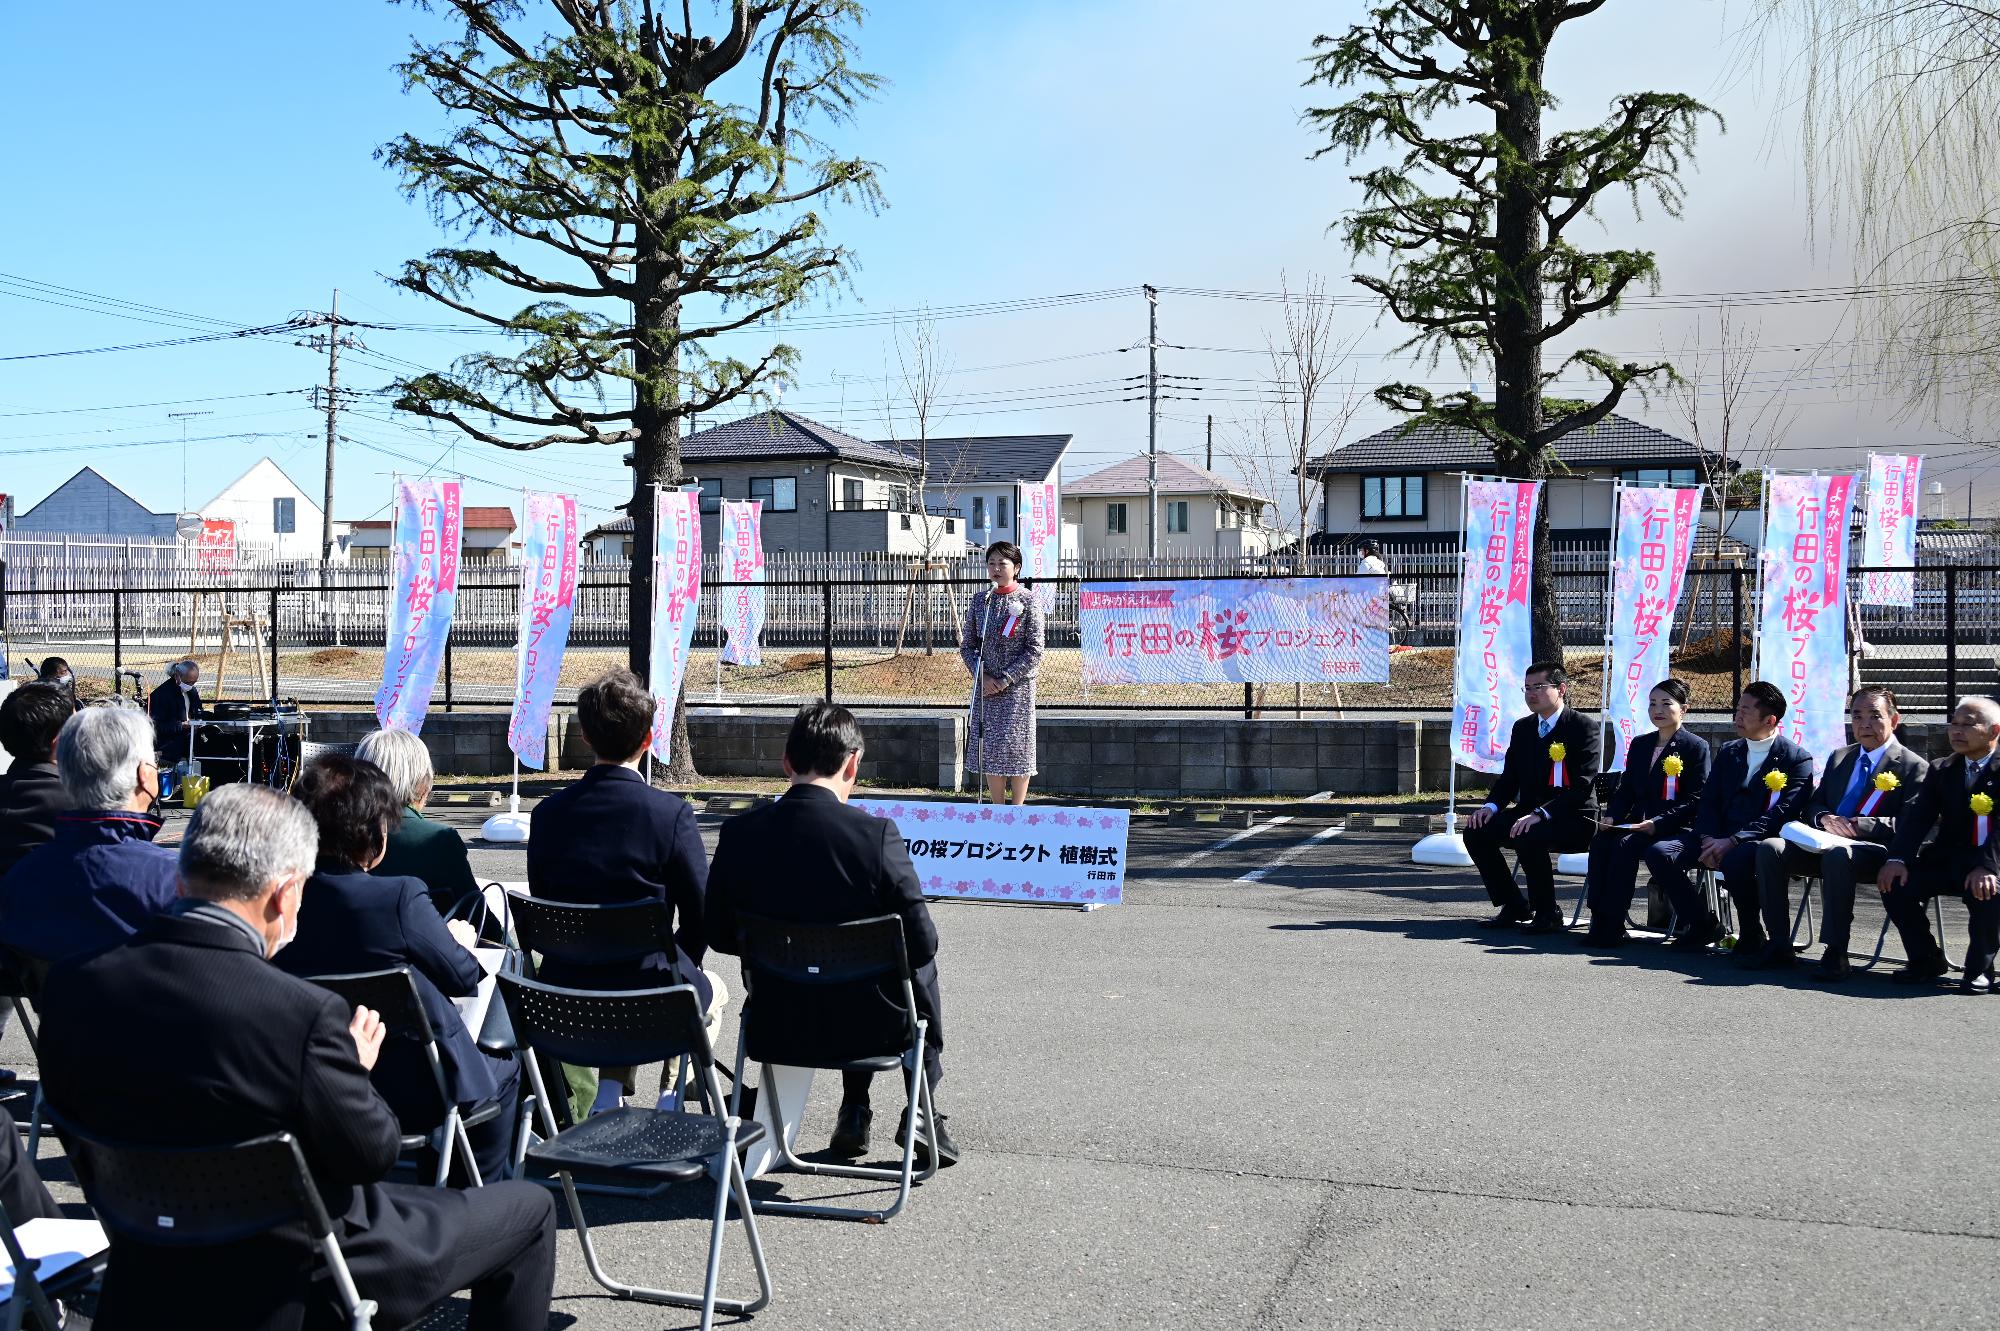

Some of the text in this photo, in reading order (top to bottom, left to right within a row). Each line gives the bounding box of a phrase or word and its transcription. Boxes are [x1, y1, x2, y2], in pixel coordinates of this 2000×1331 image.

[442, 490, 458, 581] よみがえれ！
[1513, 492, 1530, 591] よみがえれ！
[1826, 486, 1844, 593] よみがえれ！
[1090, 591, 1162, 607] よみがえれ！
[1103, 608, 1363, 663] 行田の桜プロジェクト
[1478, 499, 1512, 756] 行田の桜プロジェクト
[1321, 659, 1362, 674] 行田市
[1459, 704, 1482, 754] 行田市
[1059, 844, 1118, 867] 植樹式
[1087, 870, 1117, 881] 行田市
